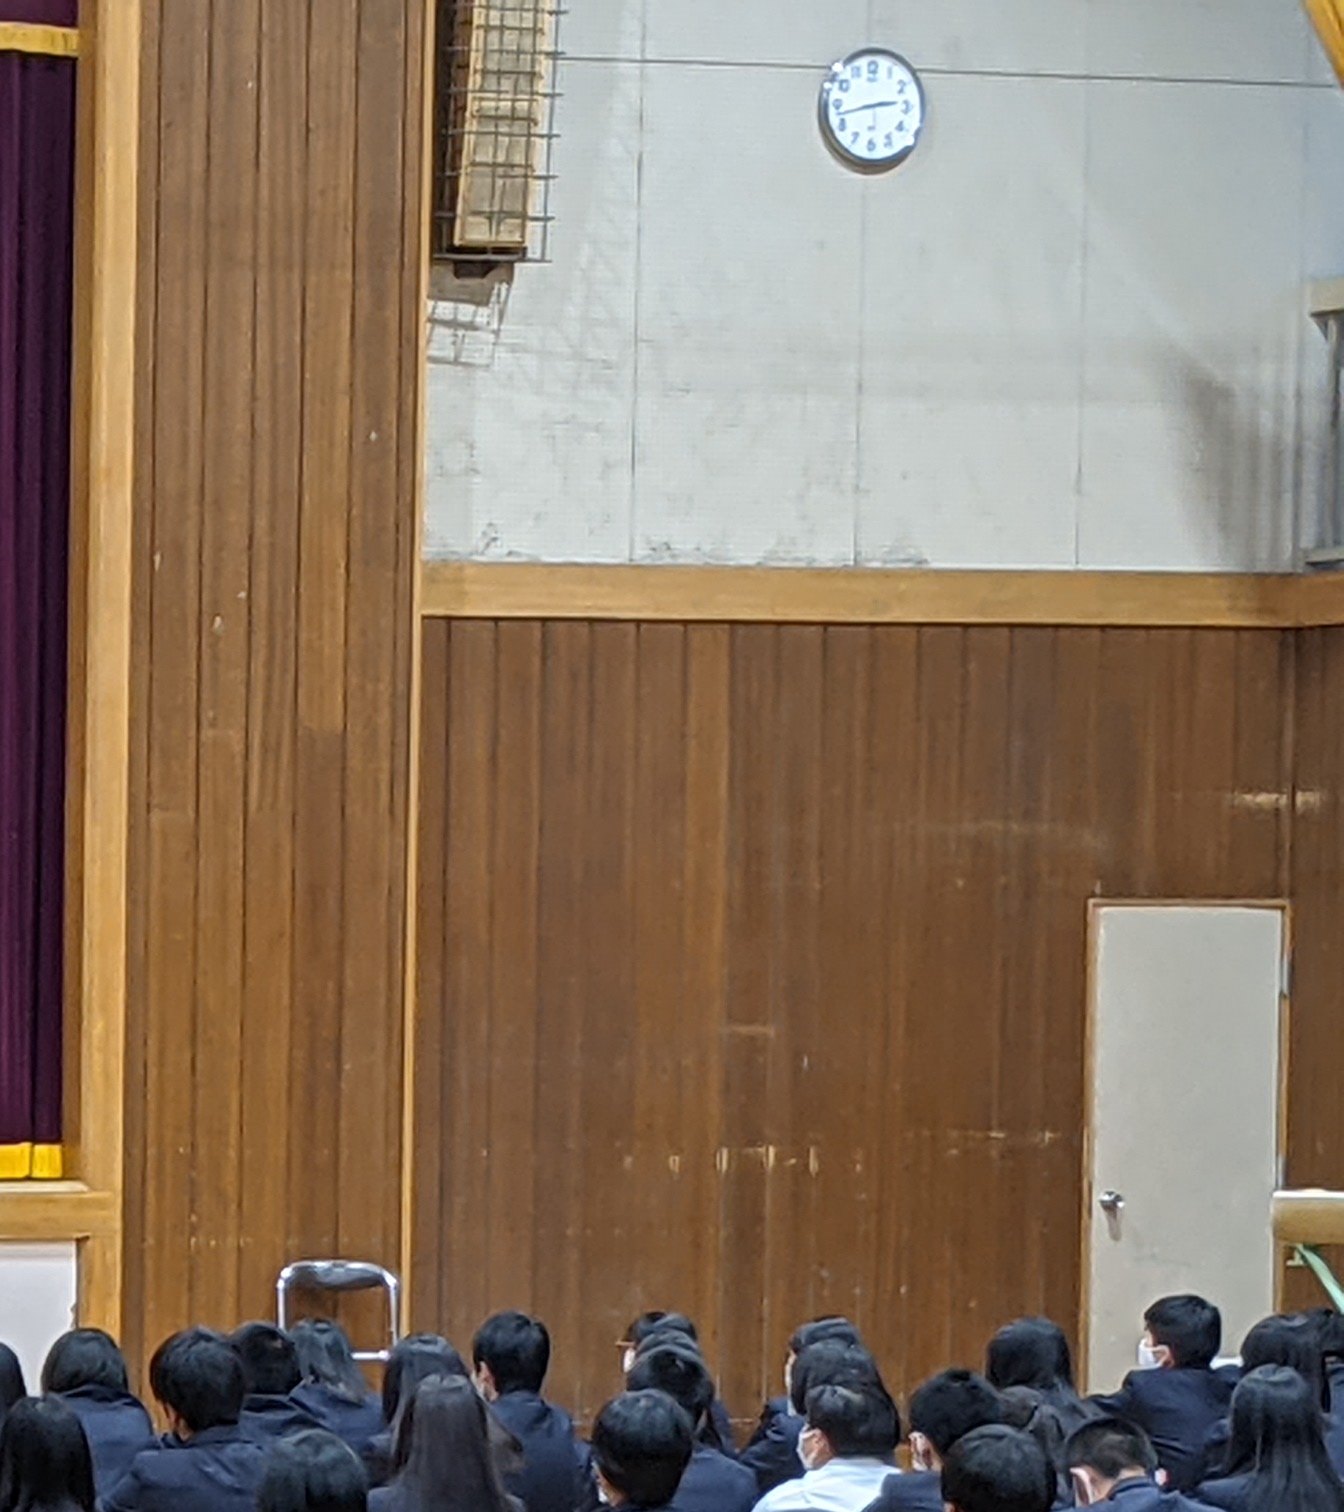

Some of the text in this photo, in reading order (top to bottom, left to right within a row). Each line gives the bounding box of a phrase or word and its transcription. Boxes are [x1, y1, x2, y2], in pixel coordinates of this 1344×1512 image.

[897, 80, 907, 95] 2
[901, 100, 913, 115] 3
[838, 118, 847, 132] 8
[895, 120, 905, 132] 4
[851, 131, 860, 144] 7
[866, 138, 876, 152] 6
